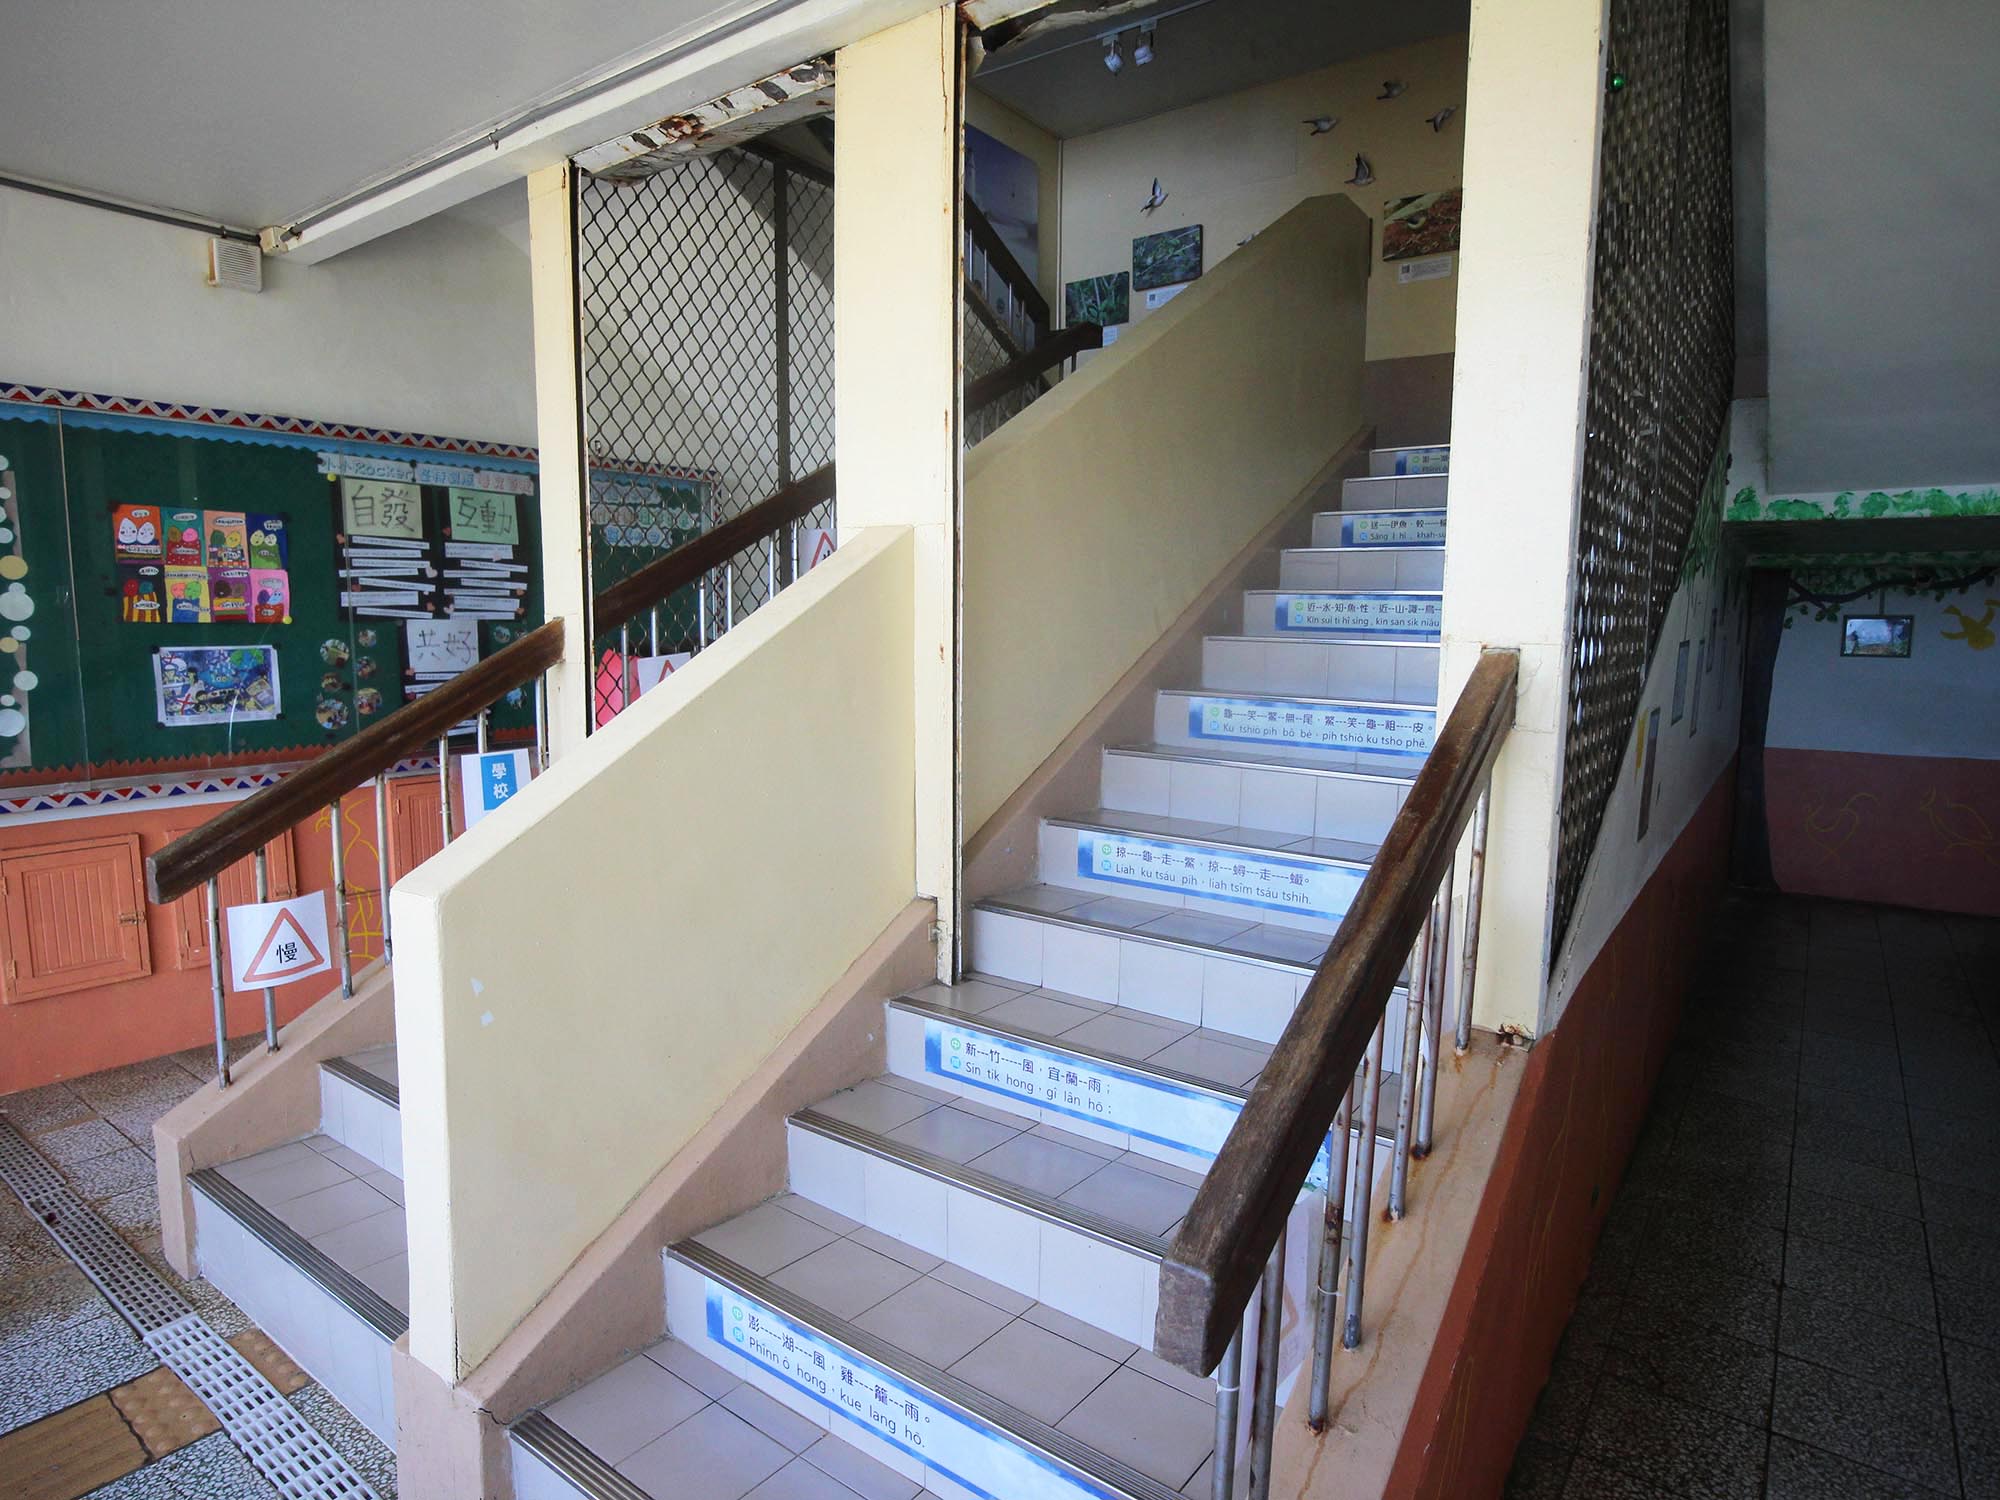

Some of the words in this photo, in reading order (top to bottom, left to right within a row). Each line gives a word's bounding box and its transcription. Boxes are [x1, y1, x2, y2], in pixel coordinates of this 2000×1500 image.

[351, 484, 415, 533] 自發
[456, 495, 513, 535] 互動
[415, 629, 477, 665] 共好
[1366, 734, 1378, 744] ku
[491, 762, 509, 799] 學校
[1141, 866, 1153, 878] ku
[276, 941, 298, 964] 慢
[965, 1061, 981, 1077] Sin
[987, 1068, 1000, 1081] tik
[840, 1387, 862, 1412] kue
[869, 1404, 896, 1435] lang
